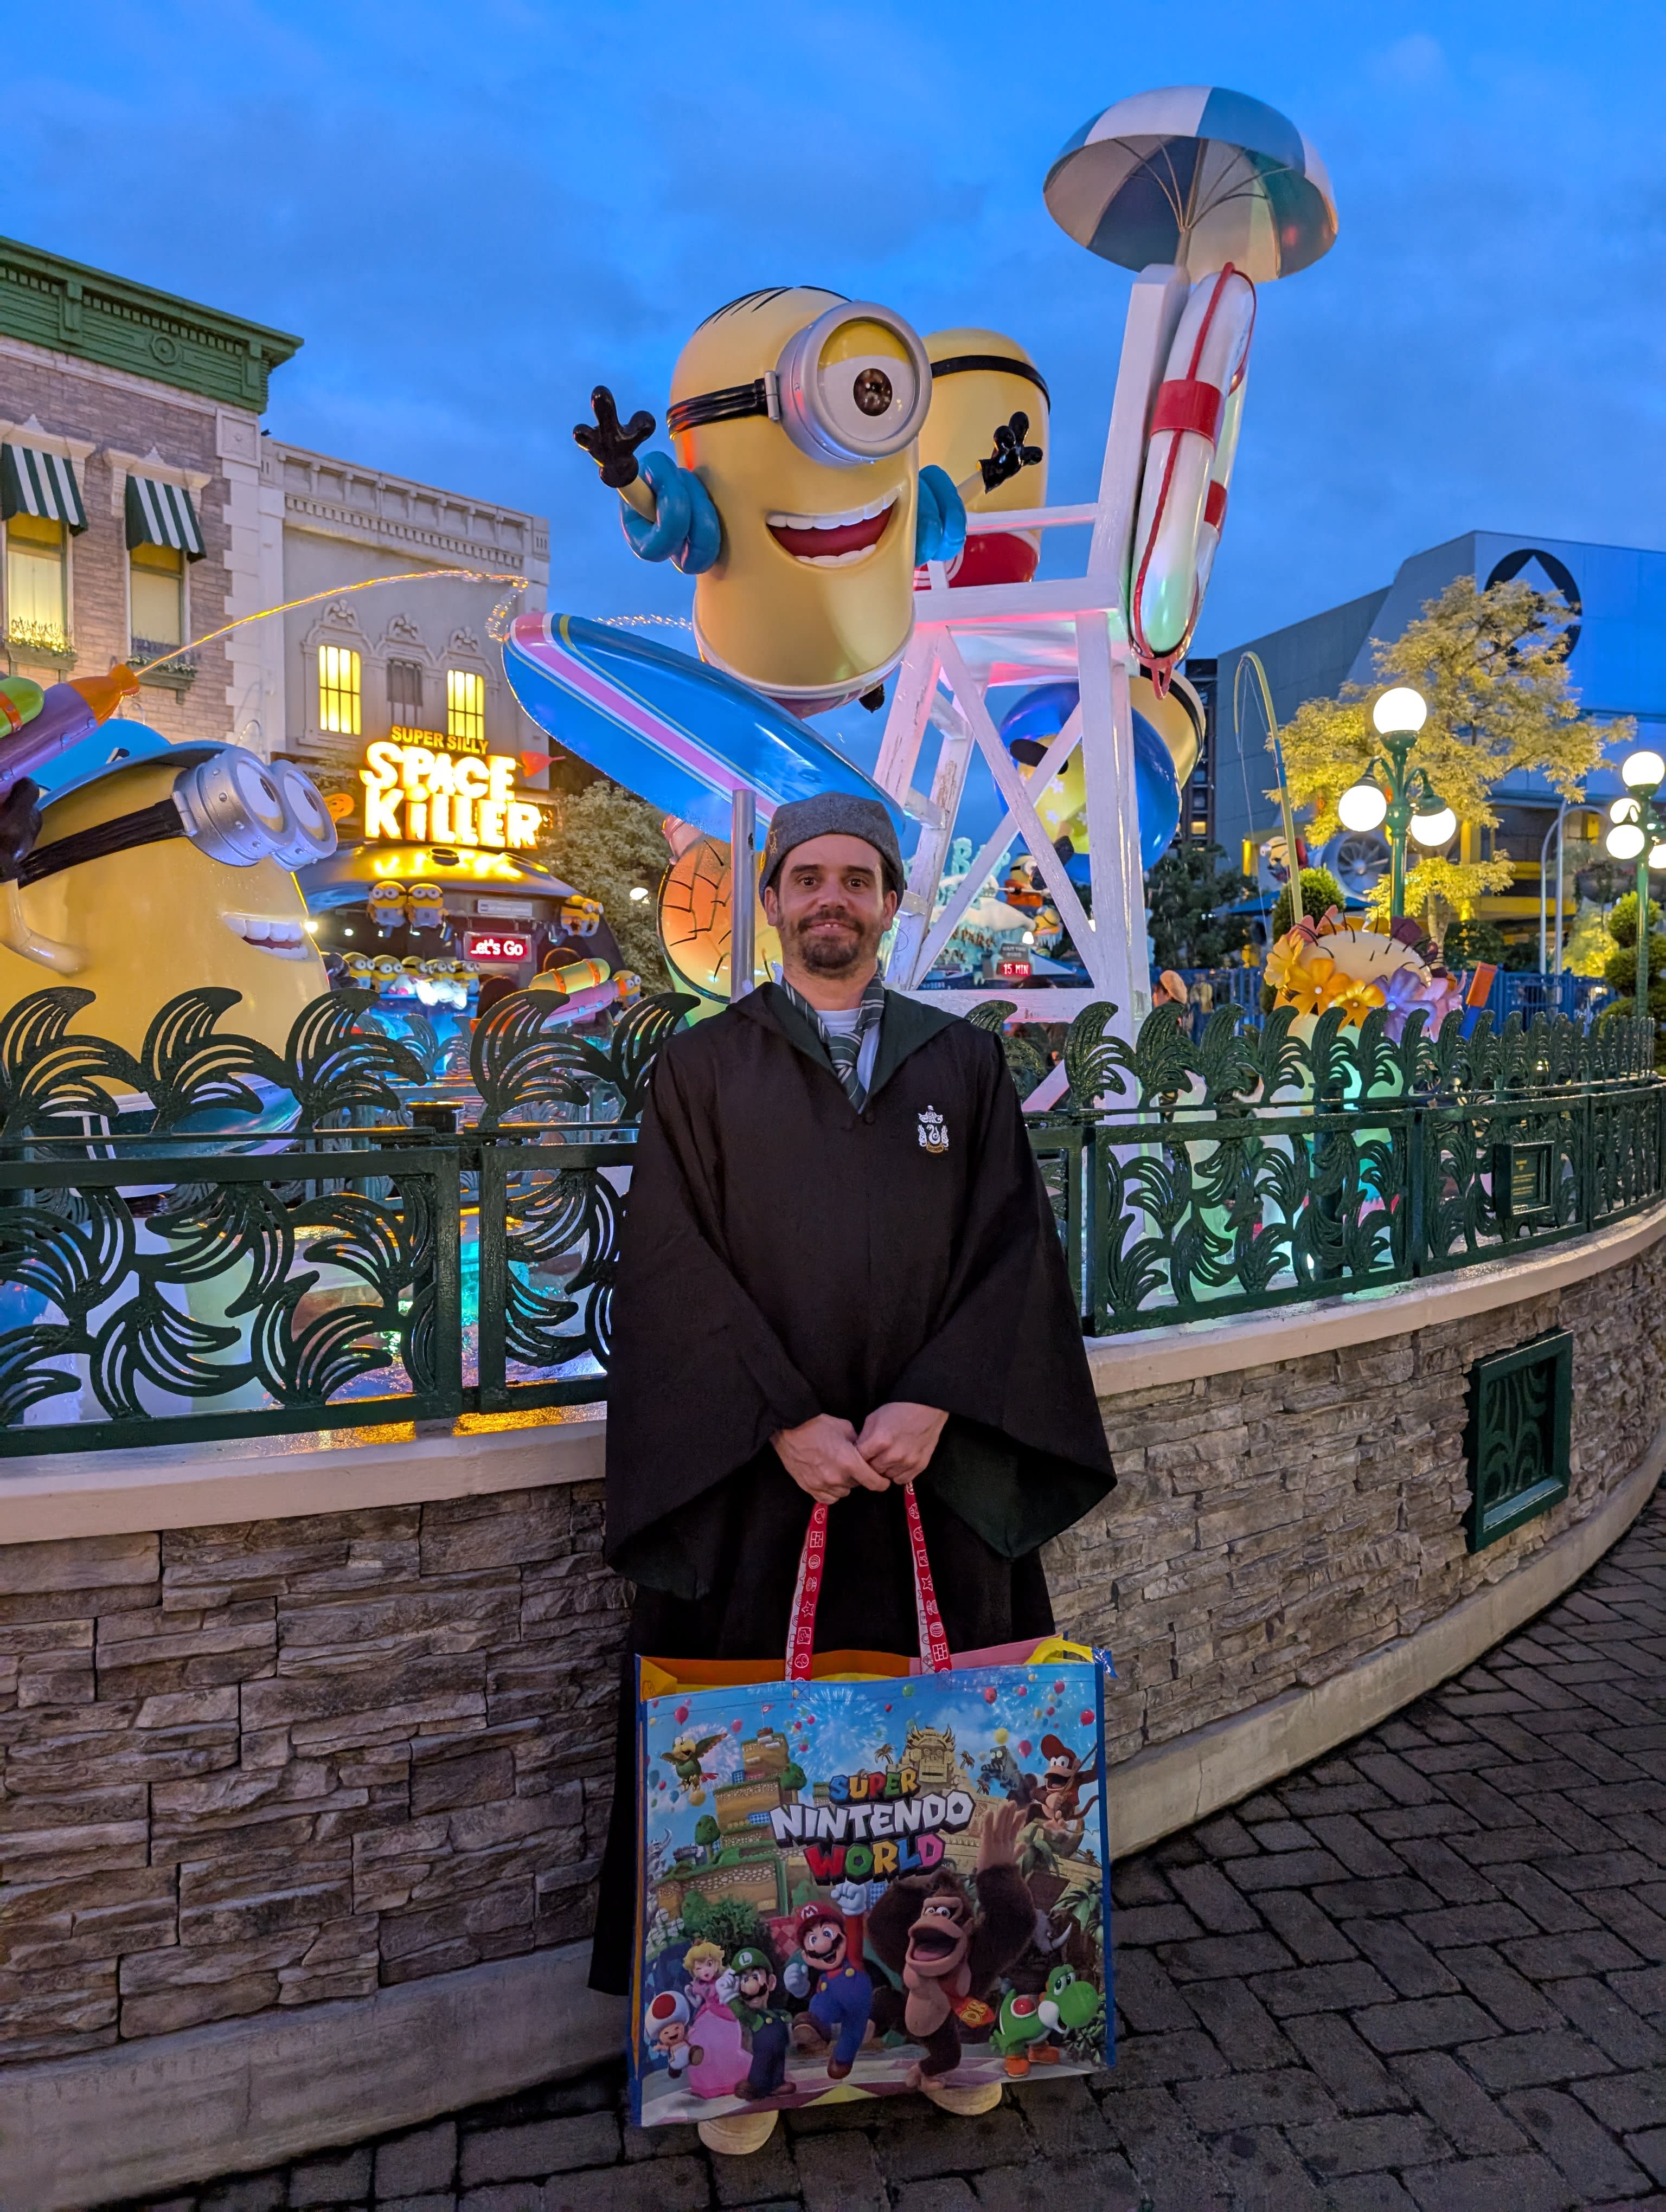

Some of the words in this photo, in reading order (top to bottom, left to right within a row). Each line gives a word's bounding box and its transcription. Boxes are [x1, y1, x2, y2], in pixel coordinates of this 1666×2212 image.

[390, 724, 444, 749] SUPER
[446, 735, 489, 755] SILLY
[358, 741, 516, 803] SPACE
[503, 940, 523, 956] Go
[1003, 963, 1013, 975] 15
[1015, 963, 1029, 975] MIN
[829, 1766, 920, 1804] SUPER
[769, 1789, 975, 1846] NINTENDO
[803, 1832, 945, 1883] WORLD
